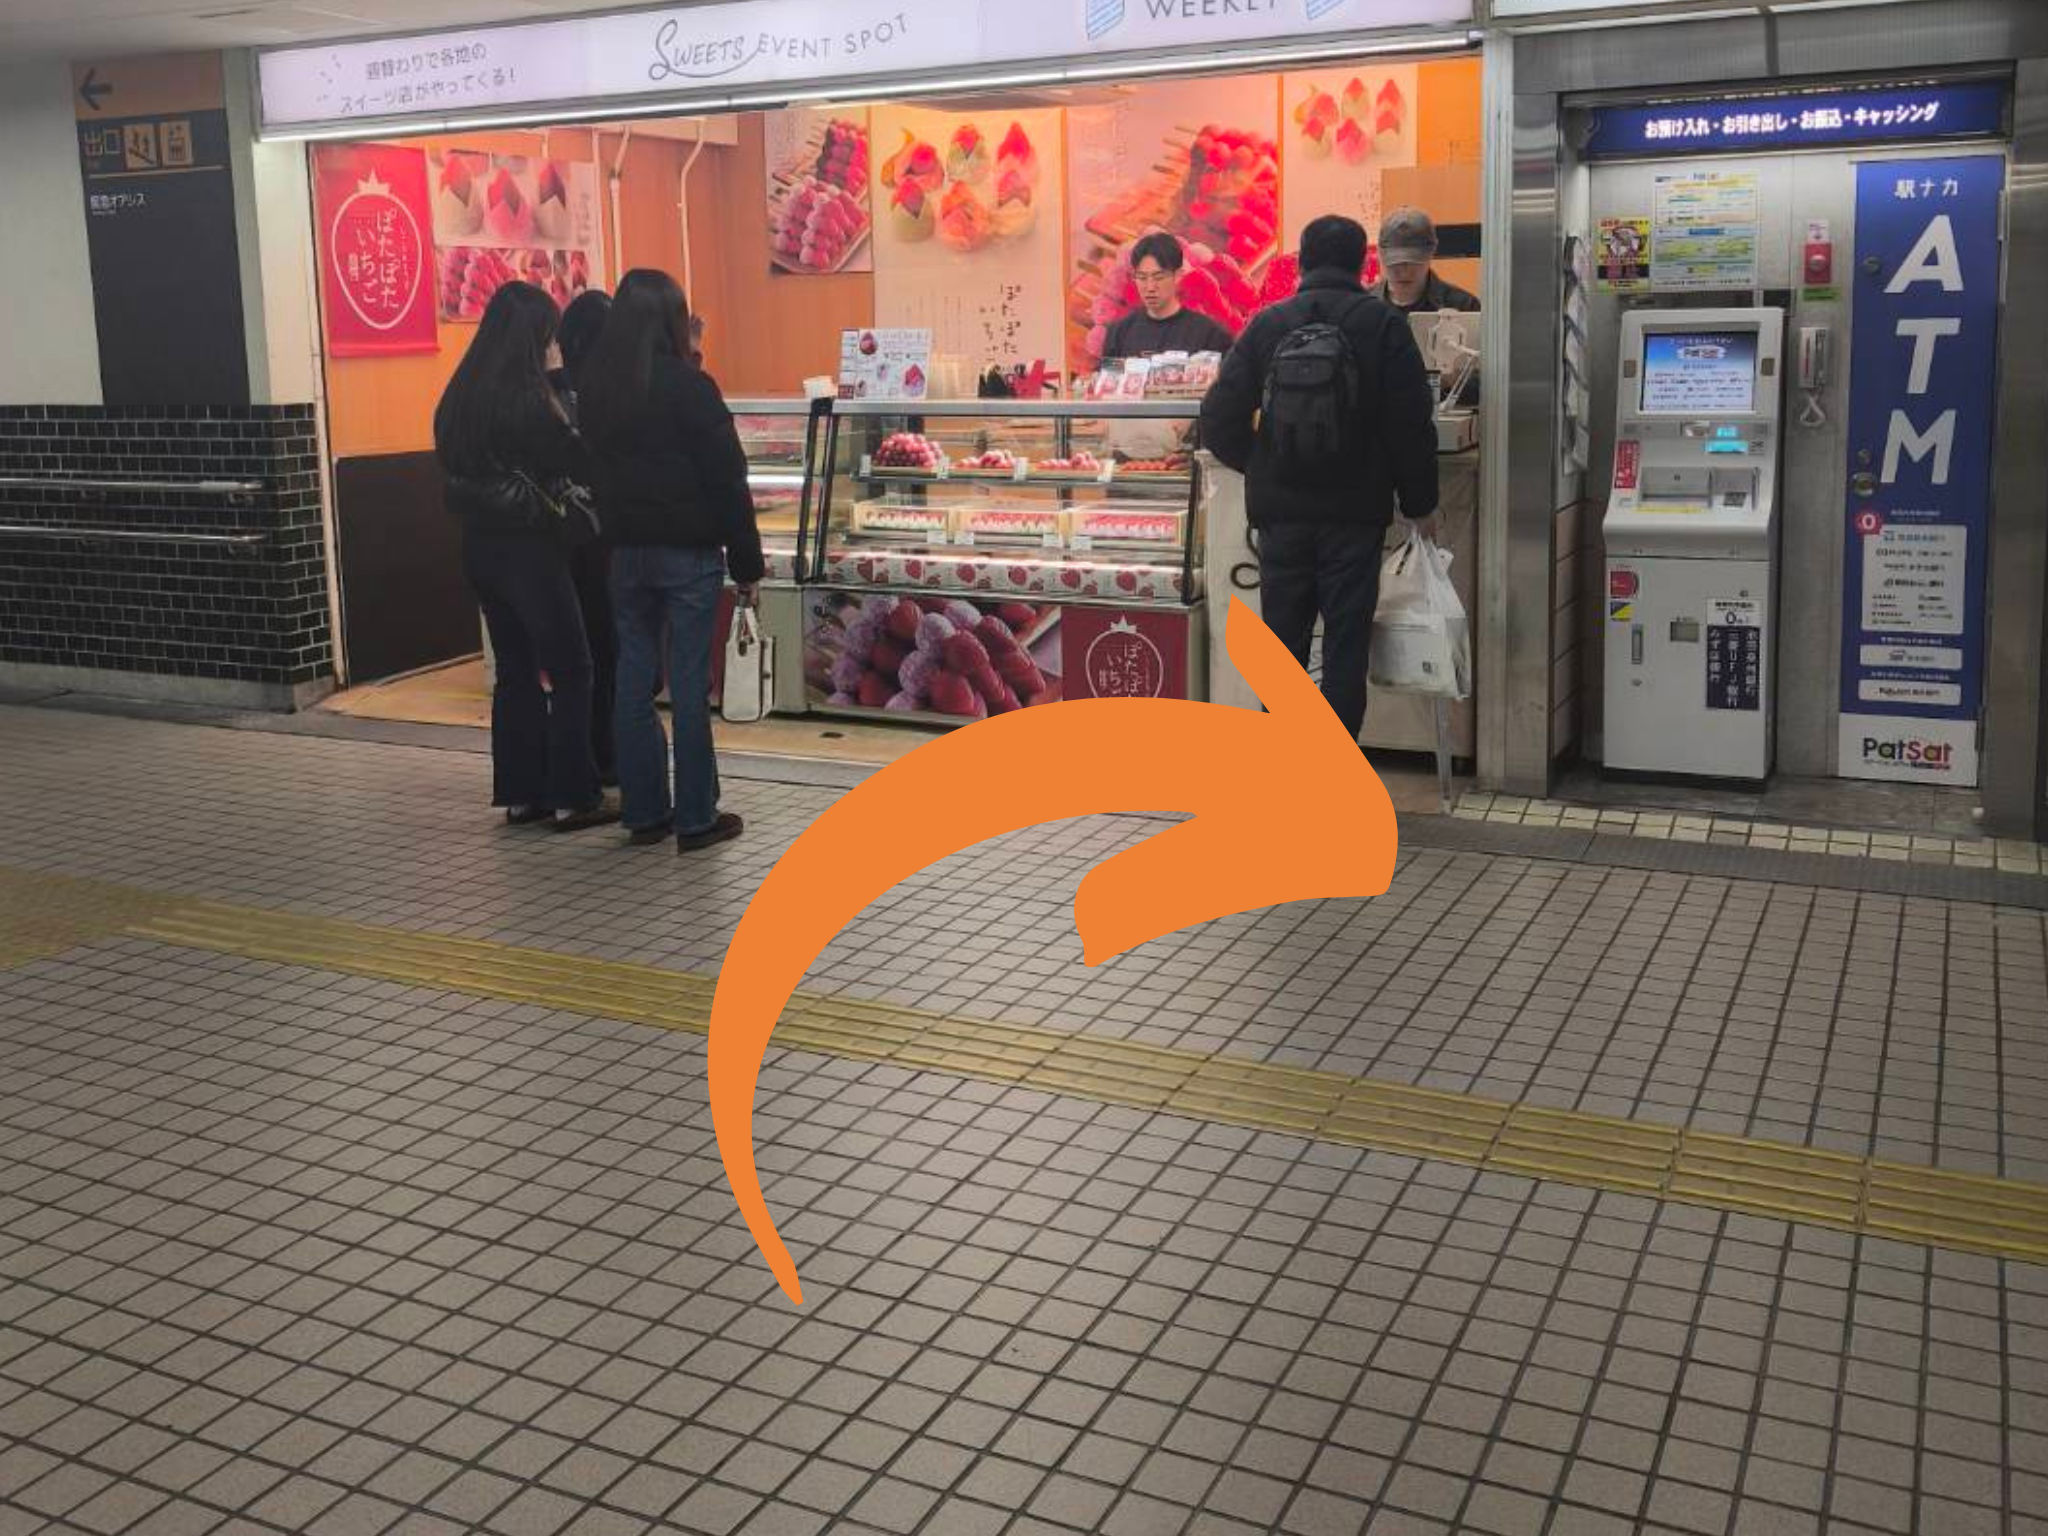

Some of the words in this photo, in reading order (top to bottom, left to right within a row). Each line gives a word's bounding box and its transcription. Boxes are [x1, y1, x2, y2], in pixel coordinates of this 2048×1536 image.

[757, 33, 831, 58] EVENT
[844, 14, 905, 53] SPOT
[366, 42, 486, 80] 週替わりで各地の
[85, 129, 122, 157] 出口
[1894, 178, 1959, 199] 駅ナカ
[355, 228, 379, 304] いちご
[376, 206, 401, 308] ぽたぽた
[1880, 214, 1964, 485] ATM
[1124, 640, 1143, 697] ぽたぽ
[1862, 737, 1954, 763] PatSat
